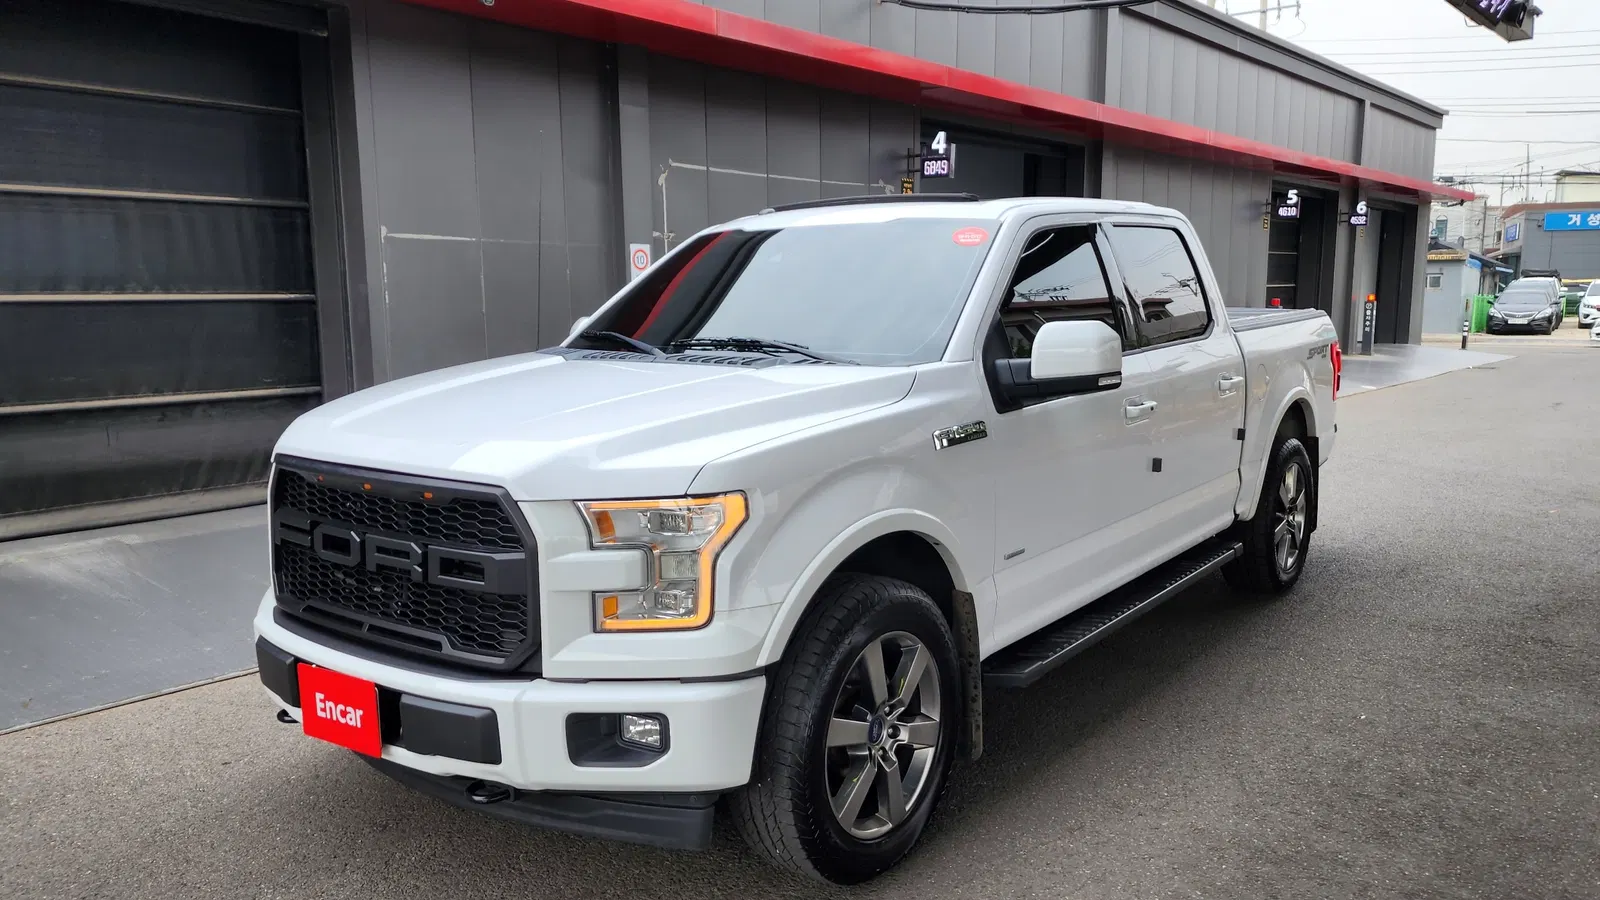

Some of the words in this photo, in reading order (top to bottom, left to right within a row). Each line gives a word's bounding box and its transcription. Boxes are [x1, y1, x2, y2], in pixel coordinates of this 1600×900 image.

[931, 130, 947, 154] 4
[924, 160, 948, 176] 6849
[1286, 189, 1299, 204] 5
[1278, 206, 1297, 217] 4610
[1356, 201, 1367, 214] 6
[636, 255, 645, 265] 10
[274, 505, 502, 593] FORD
[315, 692, 363, 728] Encar
